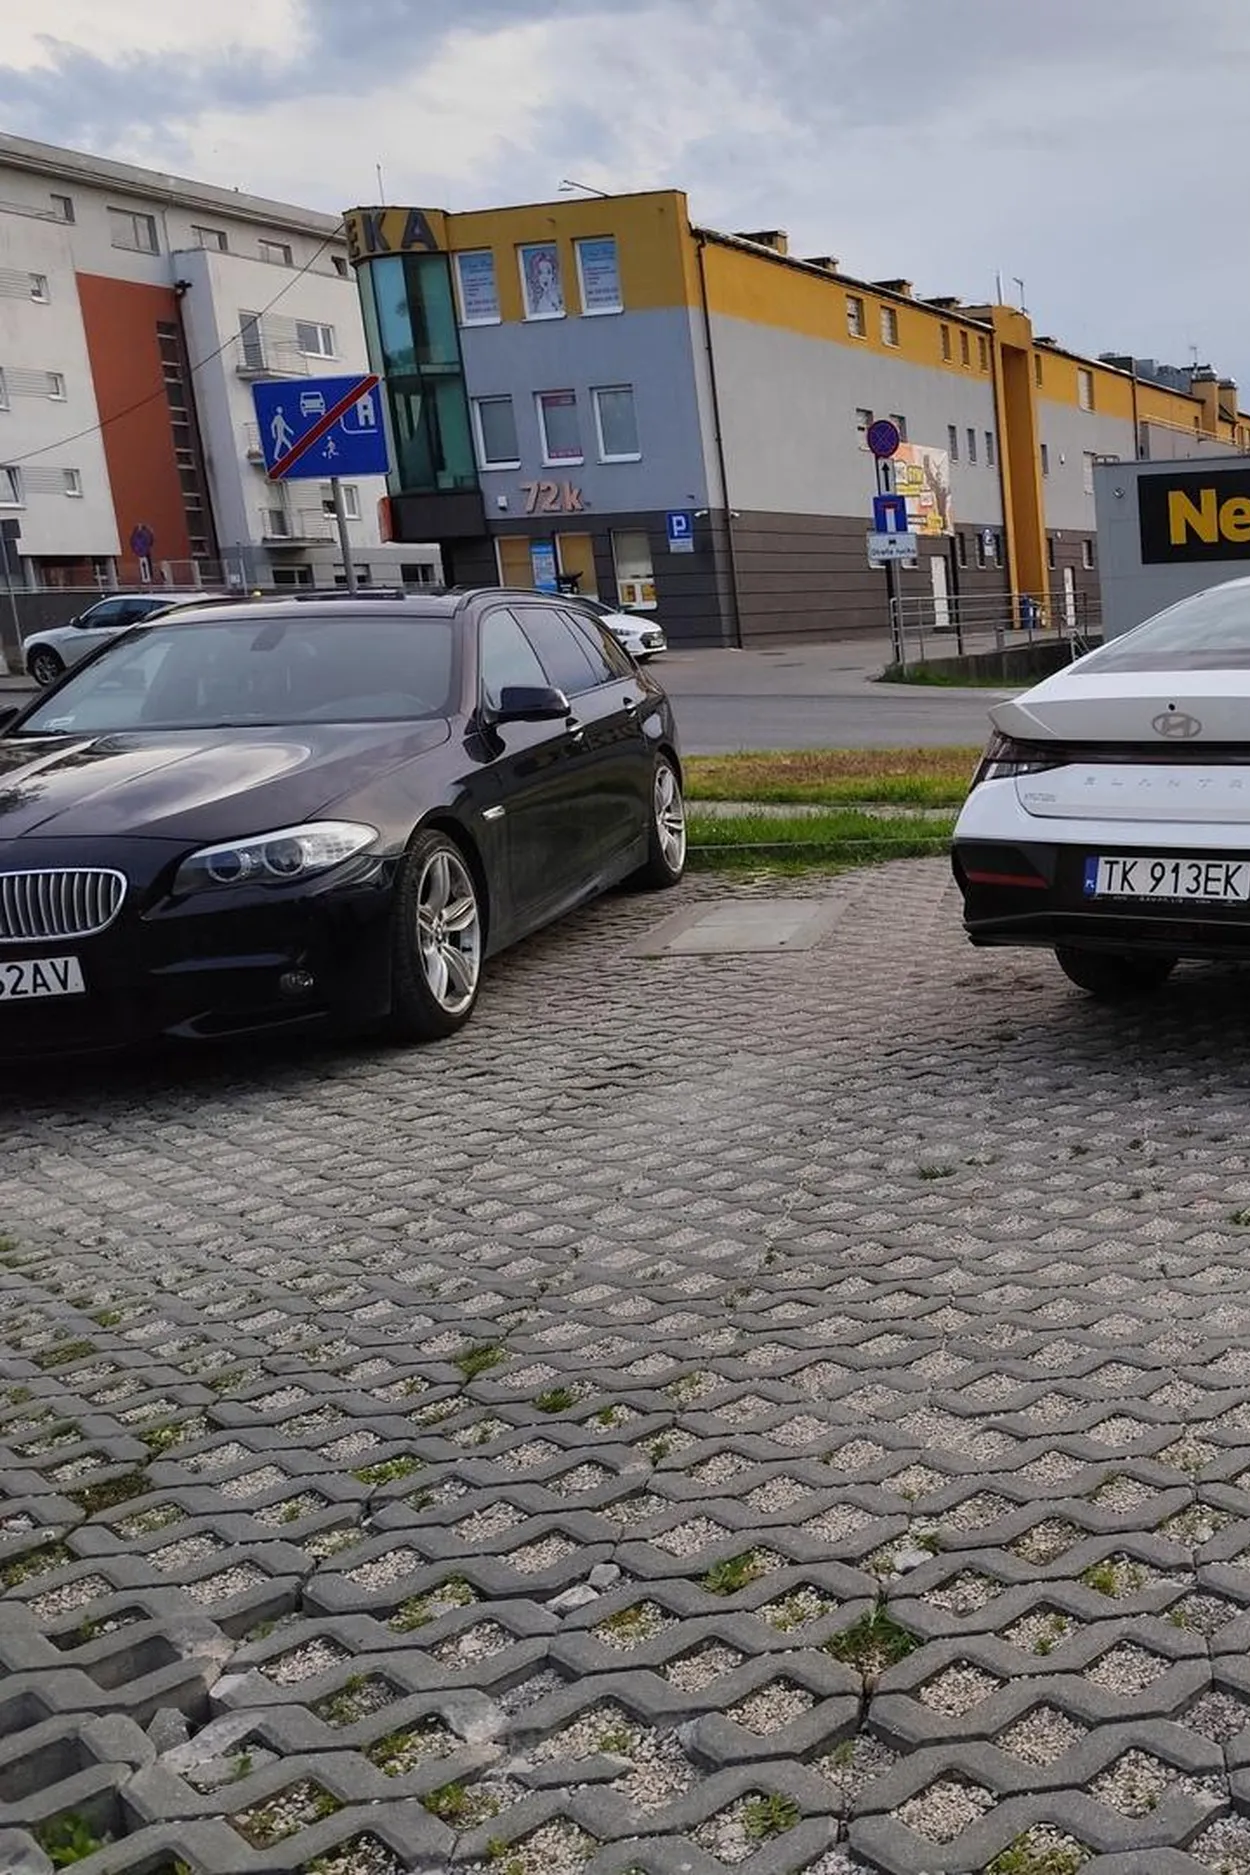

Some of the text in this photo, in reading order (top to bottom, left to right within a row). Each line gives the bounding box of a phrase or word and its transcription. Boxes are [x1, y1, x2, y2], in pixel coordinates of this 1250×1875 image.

[672, 515, 687, 537] P
[1104, 860, 1244, 897] TK 913EK
[0, 960, 69, 996] 2AV
